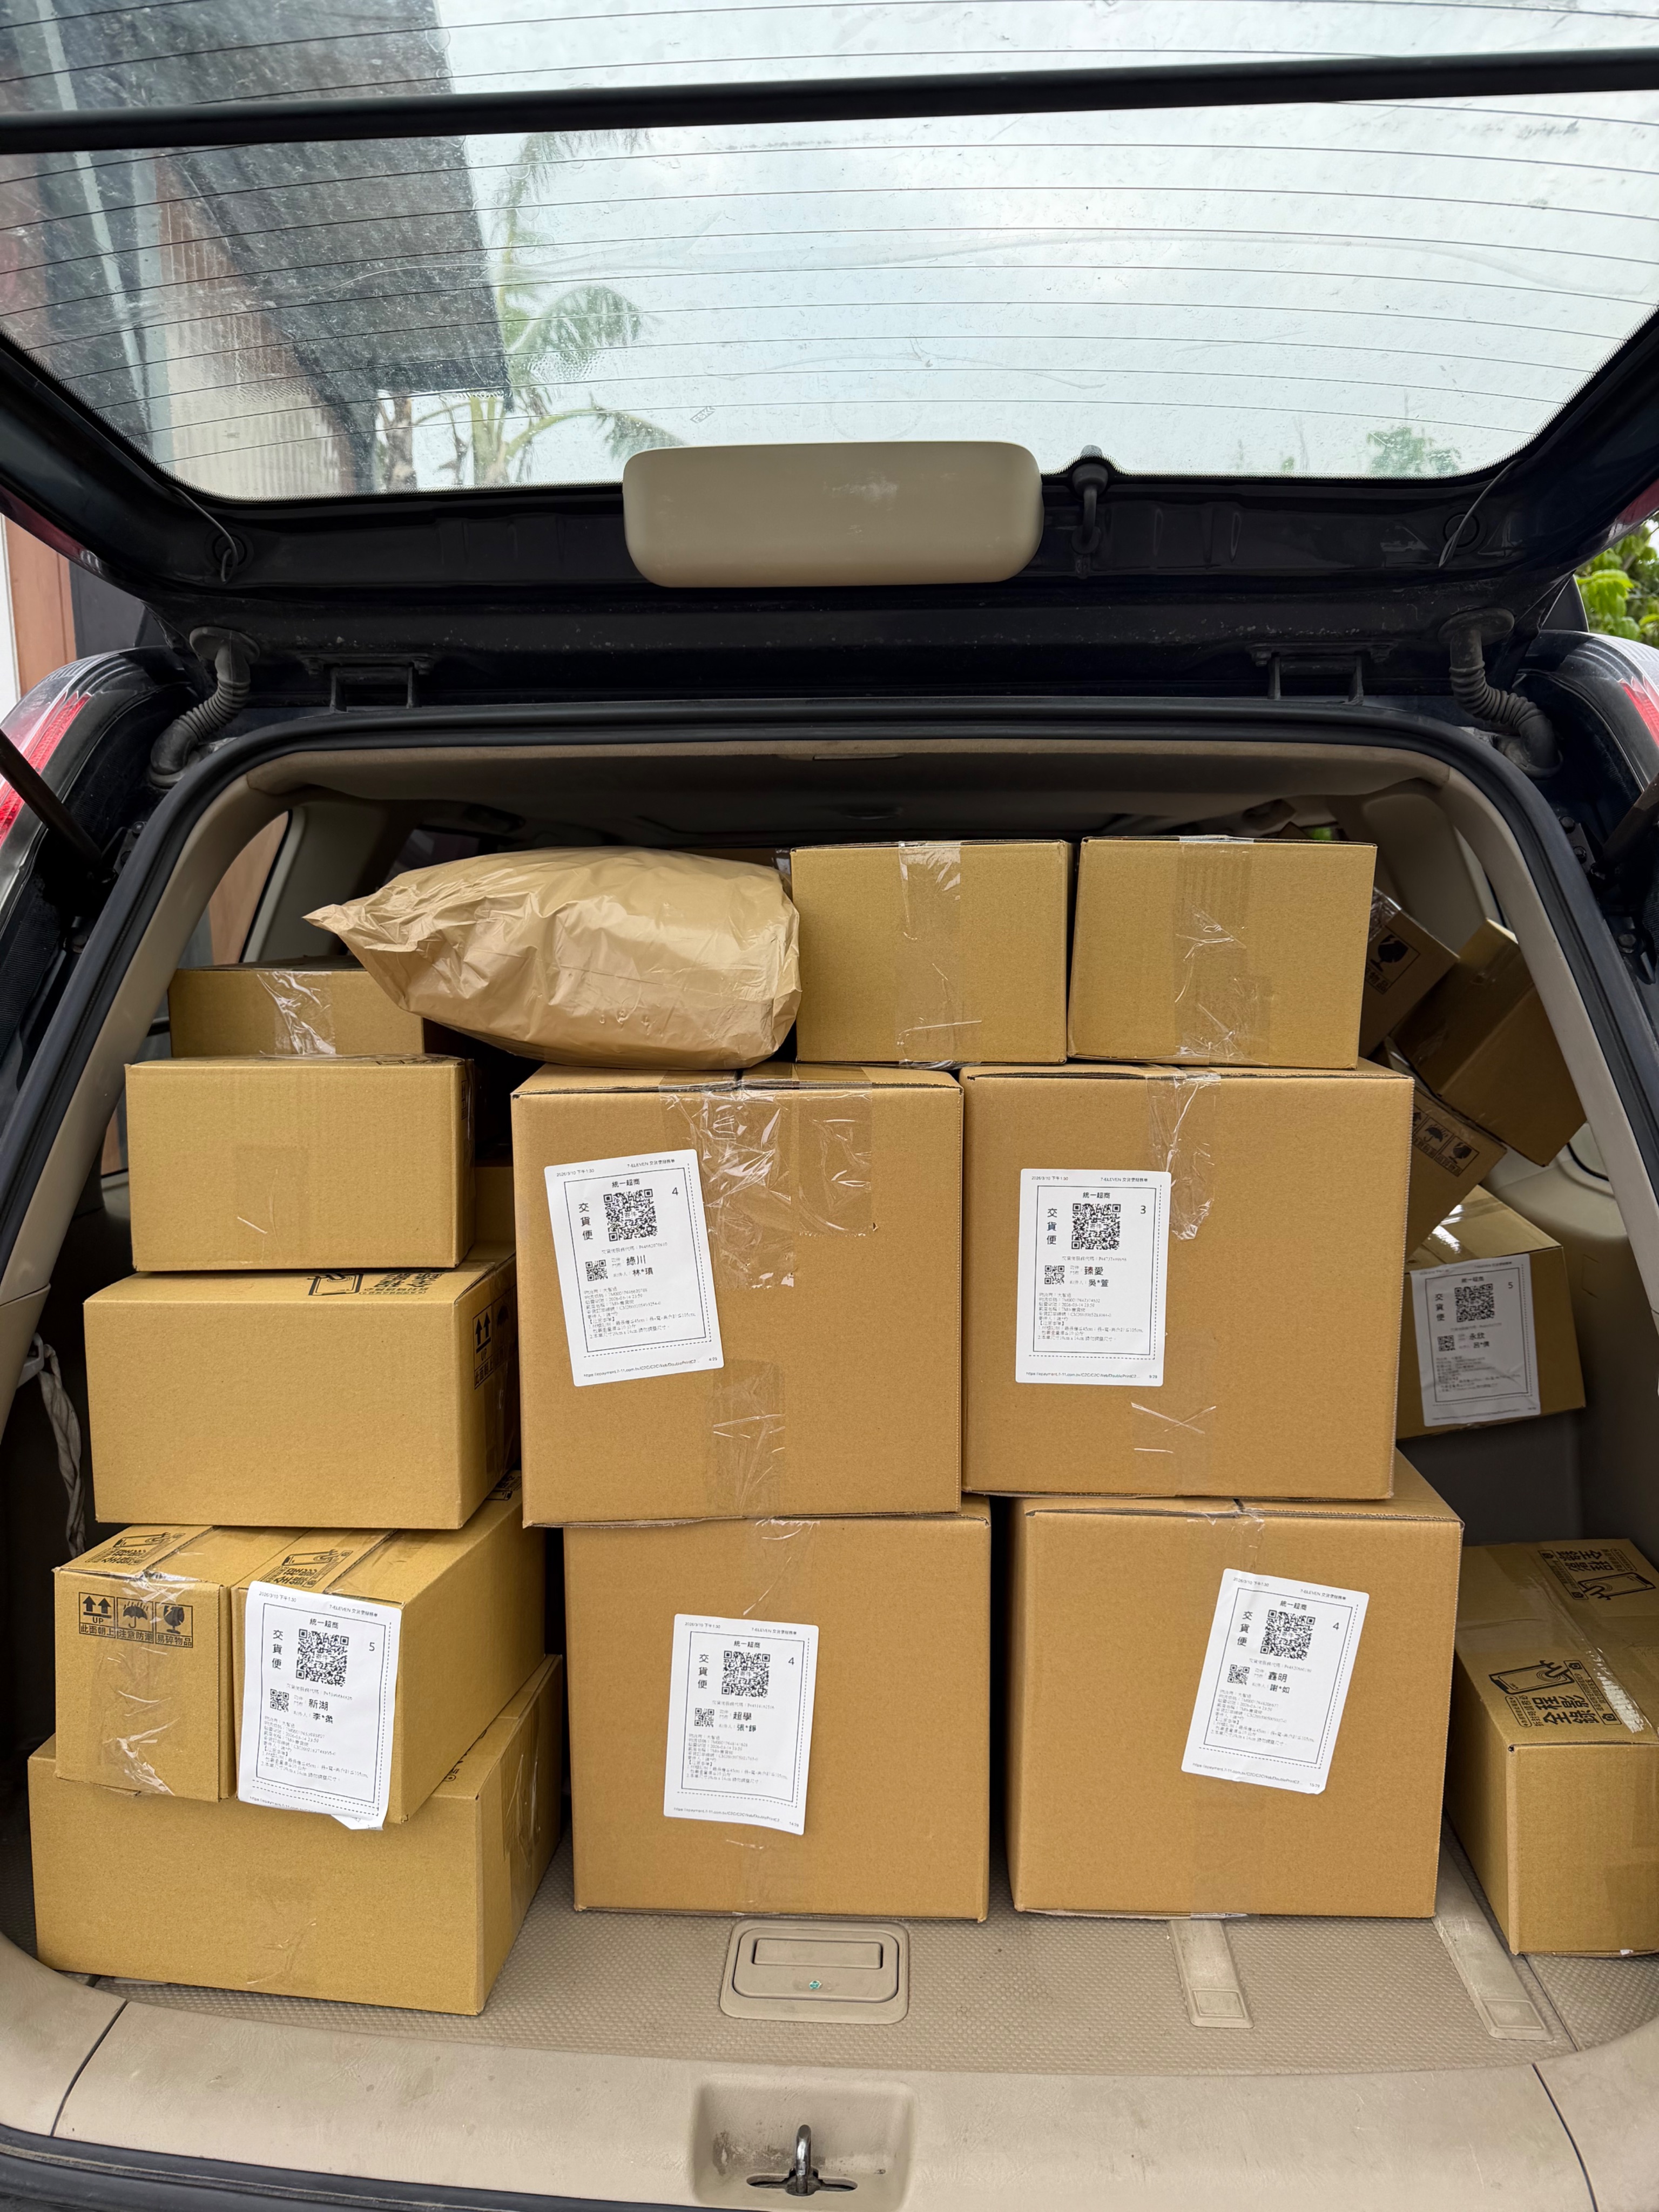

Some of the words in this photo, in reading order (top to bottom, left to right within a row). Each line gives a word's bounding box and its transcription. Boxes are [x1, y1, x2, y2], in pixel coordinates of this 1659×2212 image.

[611, 1178, 640, 1189] 統一超商
[671, 1186, 679, 1196] 4
[1140, 1205, 1147, 1214] 3
[578, 1202, 594, 1241] 交貨便
[1047, 1208, 1058, 1245] 交貨便
[625, 1254, 646, 1266] 綠川
[1084, 1265, 1104, 1276] 臻愛
[1434, 1293, 1445, 1321] 交貨便
[1579, 1550, 1614, 1570] 全程
[1279, 1600, 1308, 1610] 統一超商
[309, 1616, 338, 1629] 統一超商
[1236, 1610, 1253, 1647] 交貨便
[1332, 1621, 1340, 1630] 4
[80, 1624, 114, 1636] 此面朝上
[118, 1629, 153, 1642] 注意防潮
[157, 1634, 192, 1646] 易碎物品
[733, 1640, 761, 1649] 統一超商
[272, 1629, 284, 1670] 交貨便
[368, 1642, 375, 1652] 5
[788, 1657, 795, 1665] 4
[697, 1653, 709, 1689] 交貨便
[1267, 1670, 1288, 1683] 鑫明
[308, 1697, 328, 1712] 新湖
[1532, 1696, 1572, 1725] 全程
[1558, 1695, 1600, 1724] 錄影
[732, 1710, 752, 1722] 超學
